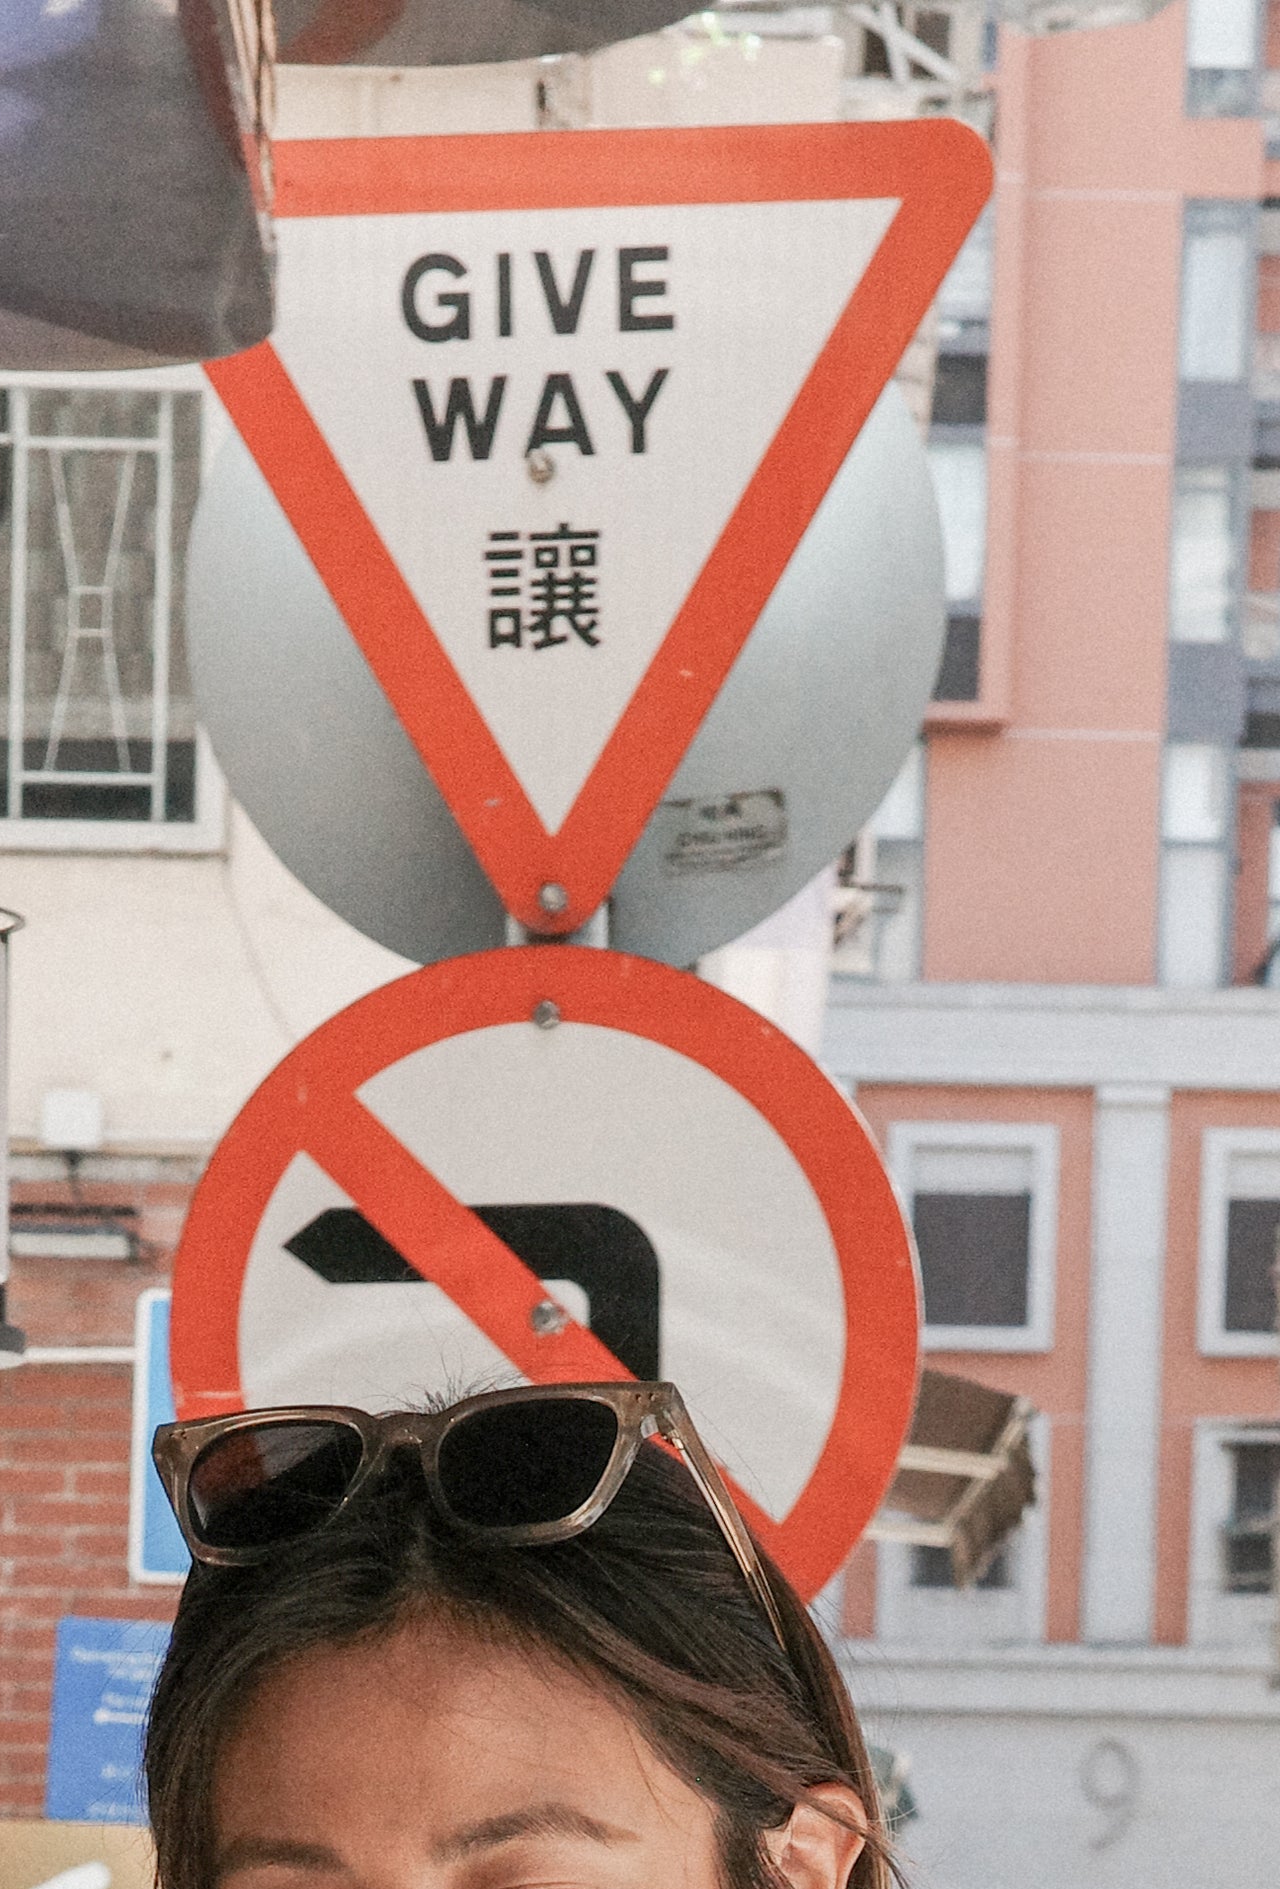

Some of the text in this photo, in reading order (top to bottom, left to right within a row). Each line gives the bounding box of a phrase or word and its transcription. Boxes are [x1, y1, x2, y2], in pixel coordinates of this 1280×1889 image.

[400, 245, 675, 343] GIVE
[412, 369, 671, 463] WAY
[484, 523, 602, 650] 讓
[1078, 1737, 1141, 1852] 9
